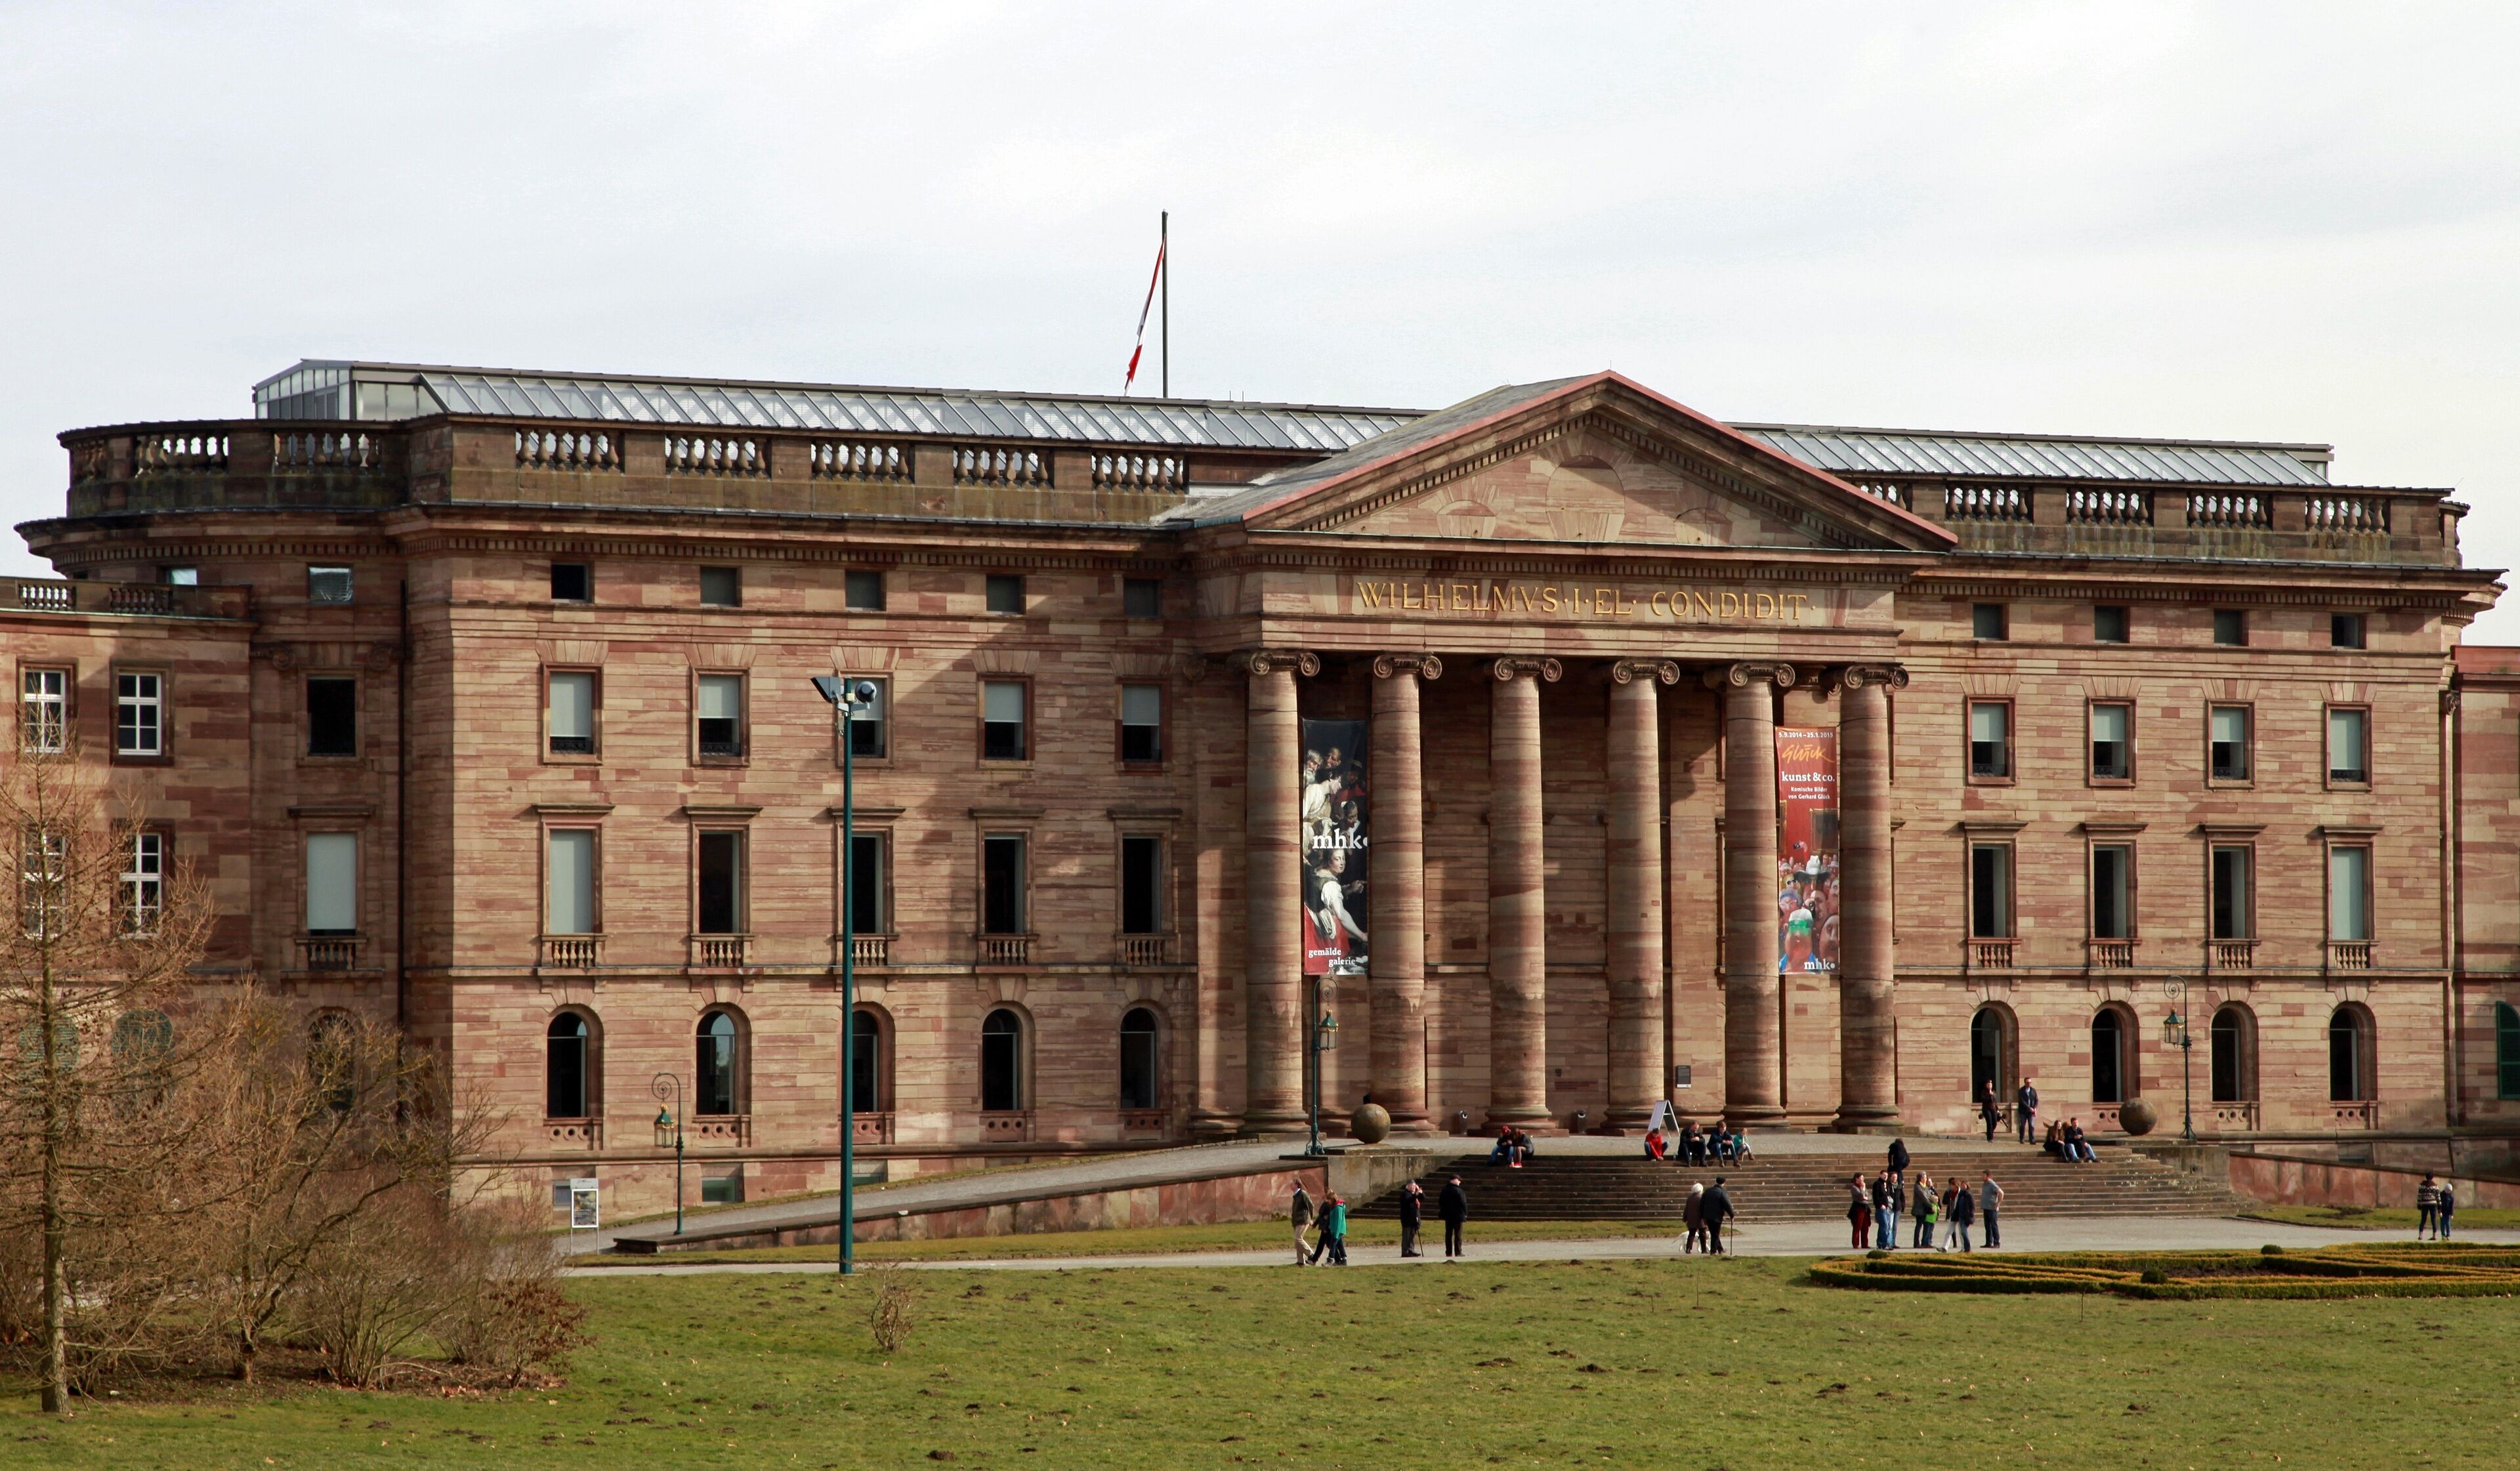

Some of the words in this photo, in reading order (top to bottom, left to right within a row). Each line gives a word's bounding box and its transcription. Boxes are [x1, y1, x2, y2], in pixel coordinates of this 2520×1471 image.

[1781, 771, 1811, 781] kunst
[1813, 772, 1821, 781] &
[1309, 947, 1341, 958] gemälde
[1329, 957, 1355, 967] galerie
